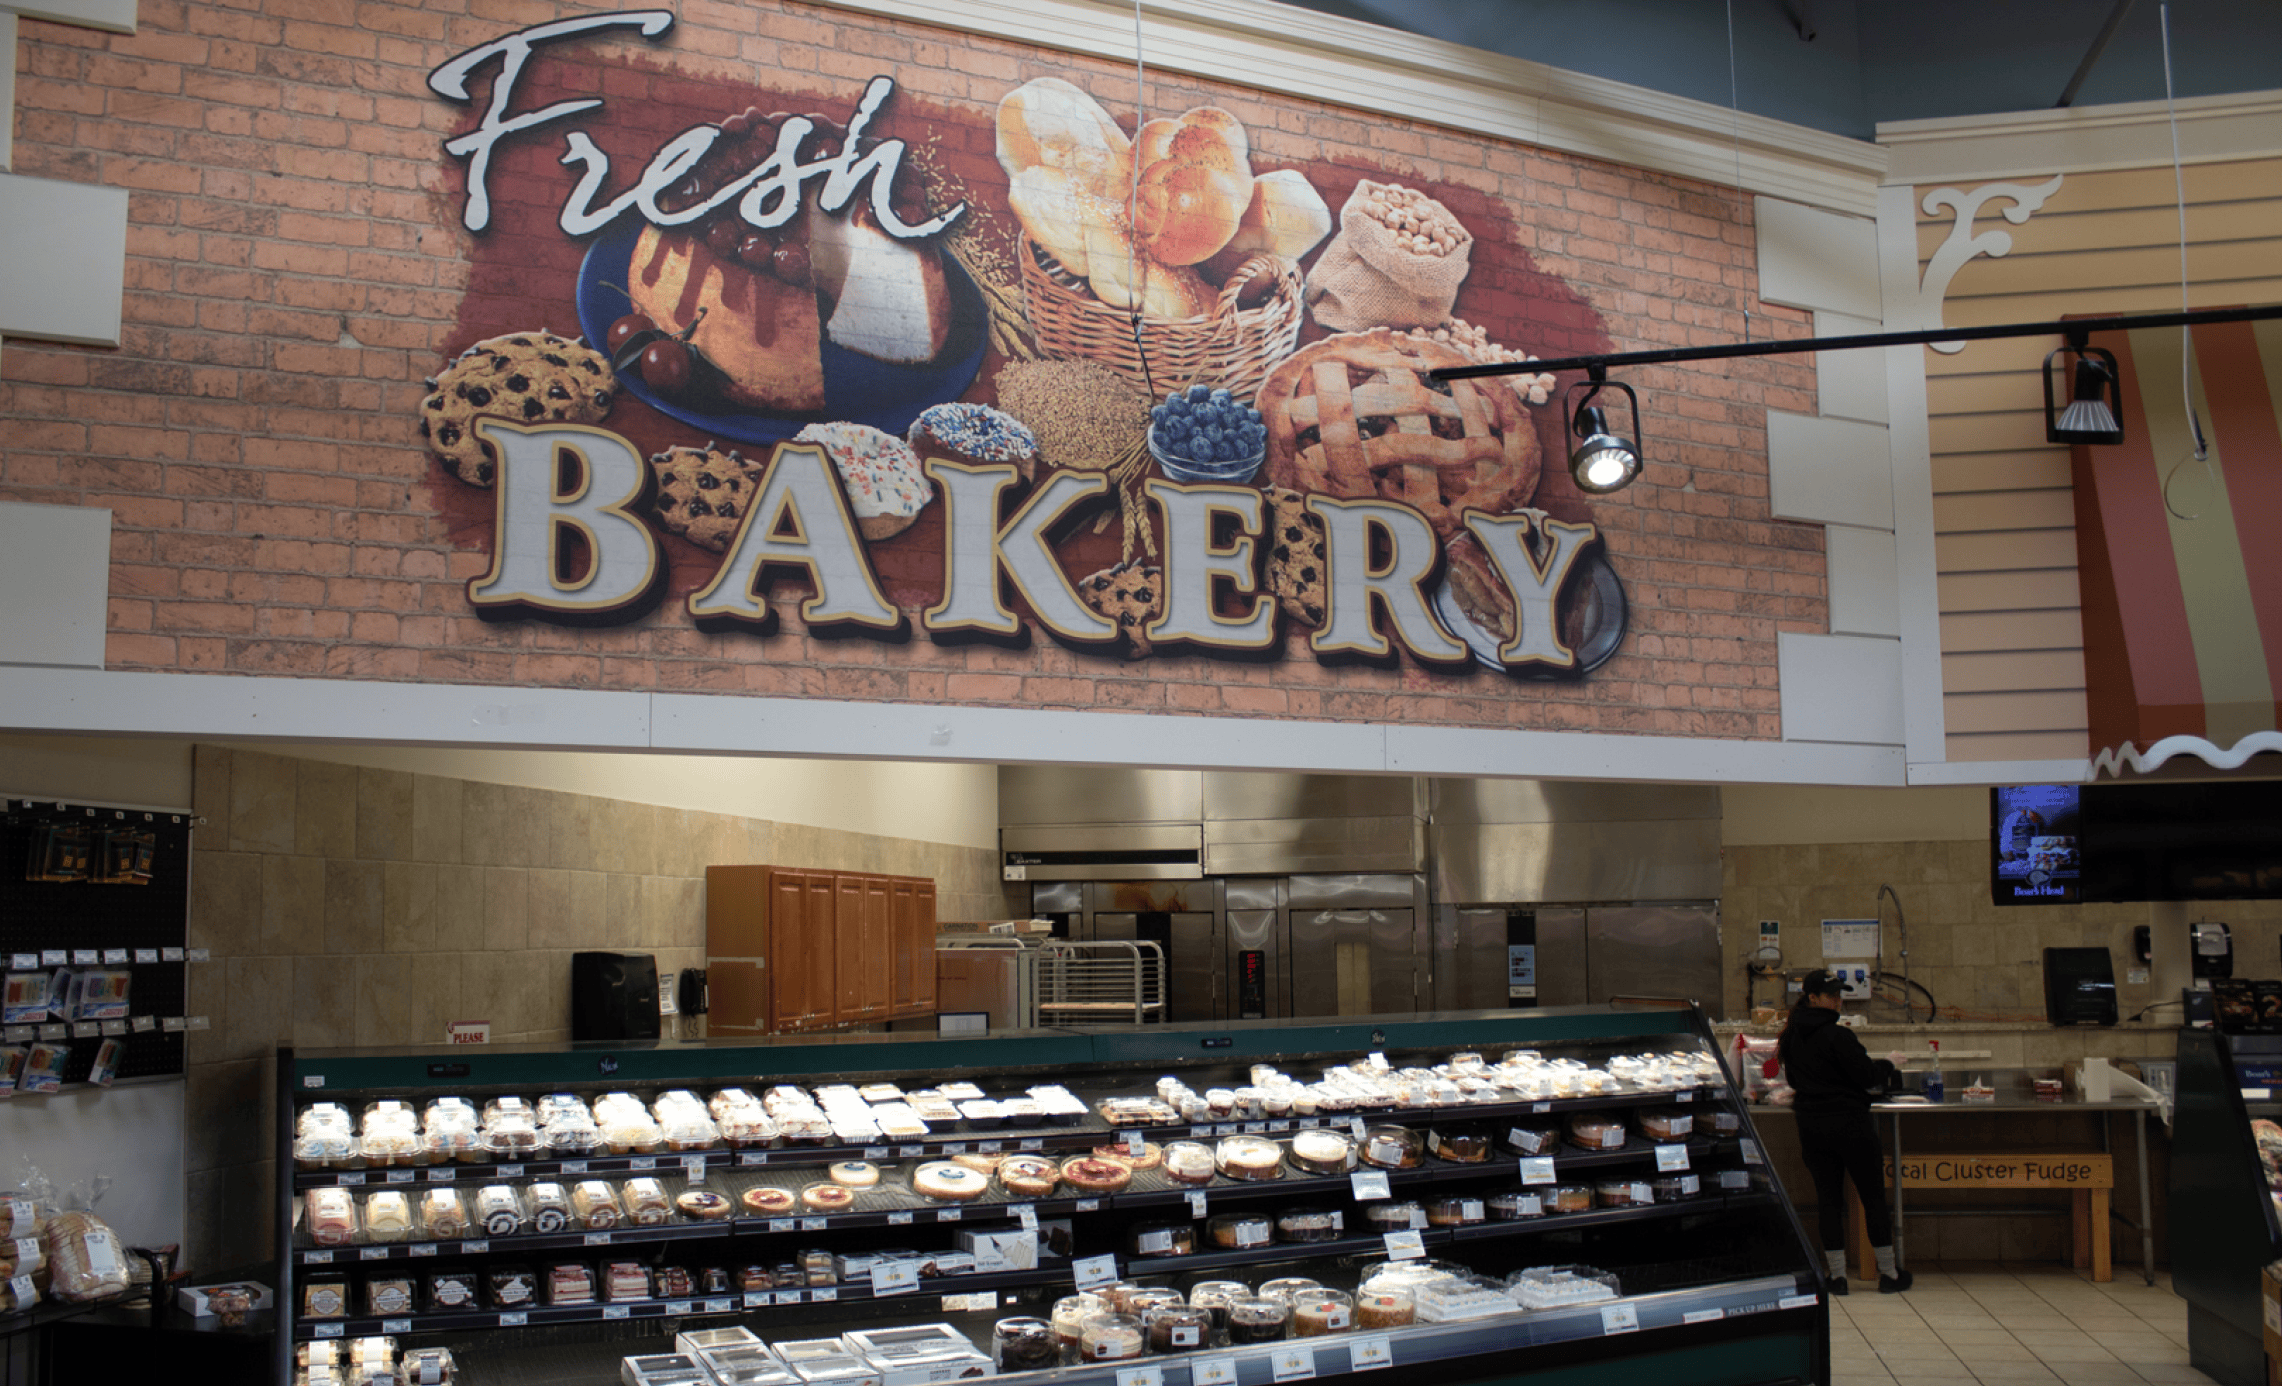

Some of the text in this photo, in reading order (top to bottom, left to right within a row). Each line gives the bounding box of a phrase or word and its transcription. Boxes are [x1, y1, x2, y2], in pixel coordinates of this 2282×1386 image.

[427, 9, 966, 239] Fresh
[468, 413, 1600, 672] BAKERY
[453, 1033, 484, 1044] PLEASE
[1882, 1162, 2092, 1182] otal Cluster Fudge
